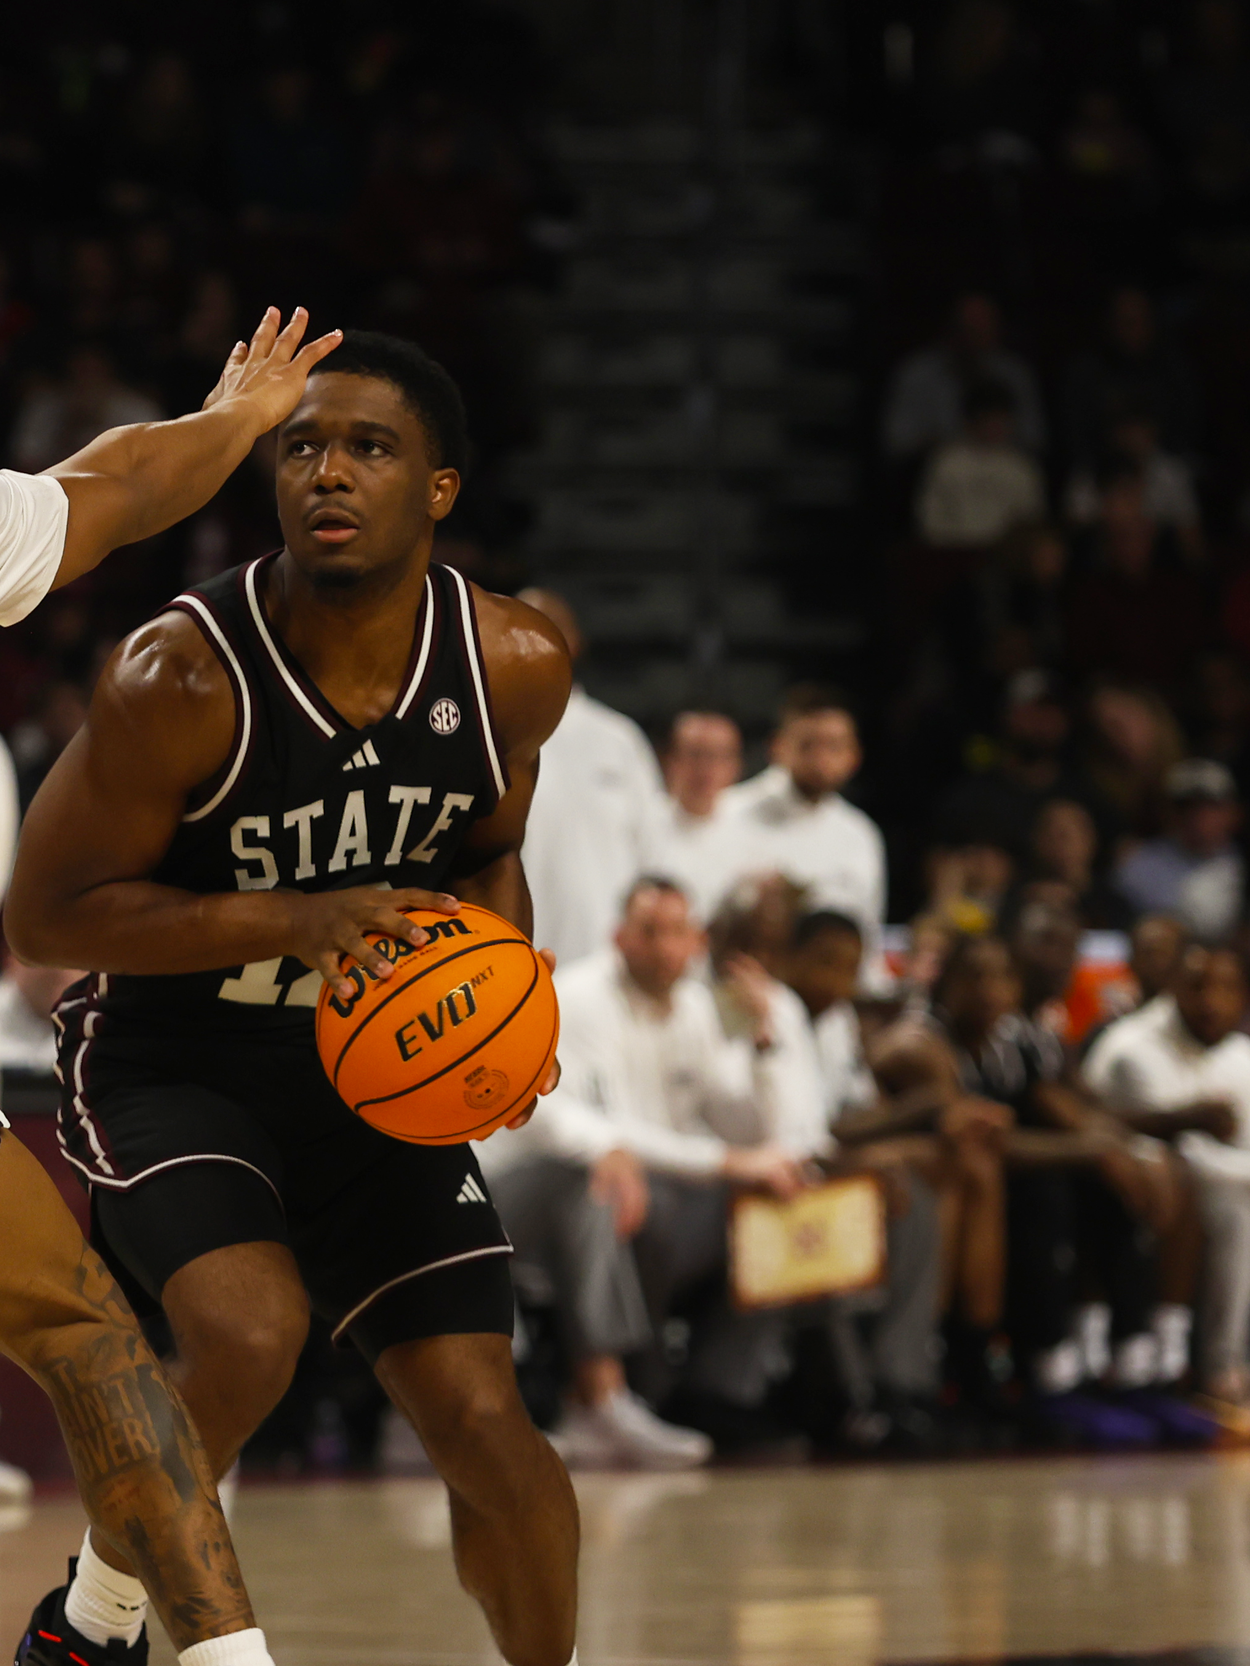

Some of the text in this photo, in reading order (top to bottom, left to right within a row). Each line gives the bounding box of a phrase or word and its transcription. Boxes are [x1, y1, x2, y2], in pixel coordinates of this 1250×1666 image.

[432, 700, 458, 732] SEC
[230, 785, 474, 891] STATE
[394, 965, 496, 1062] EVO NXT
